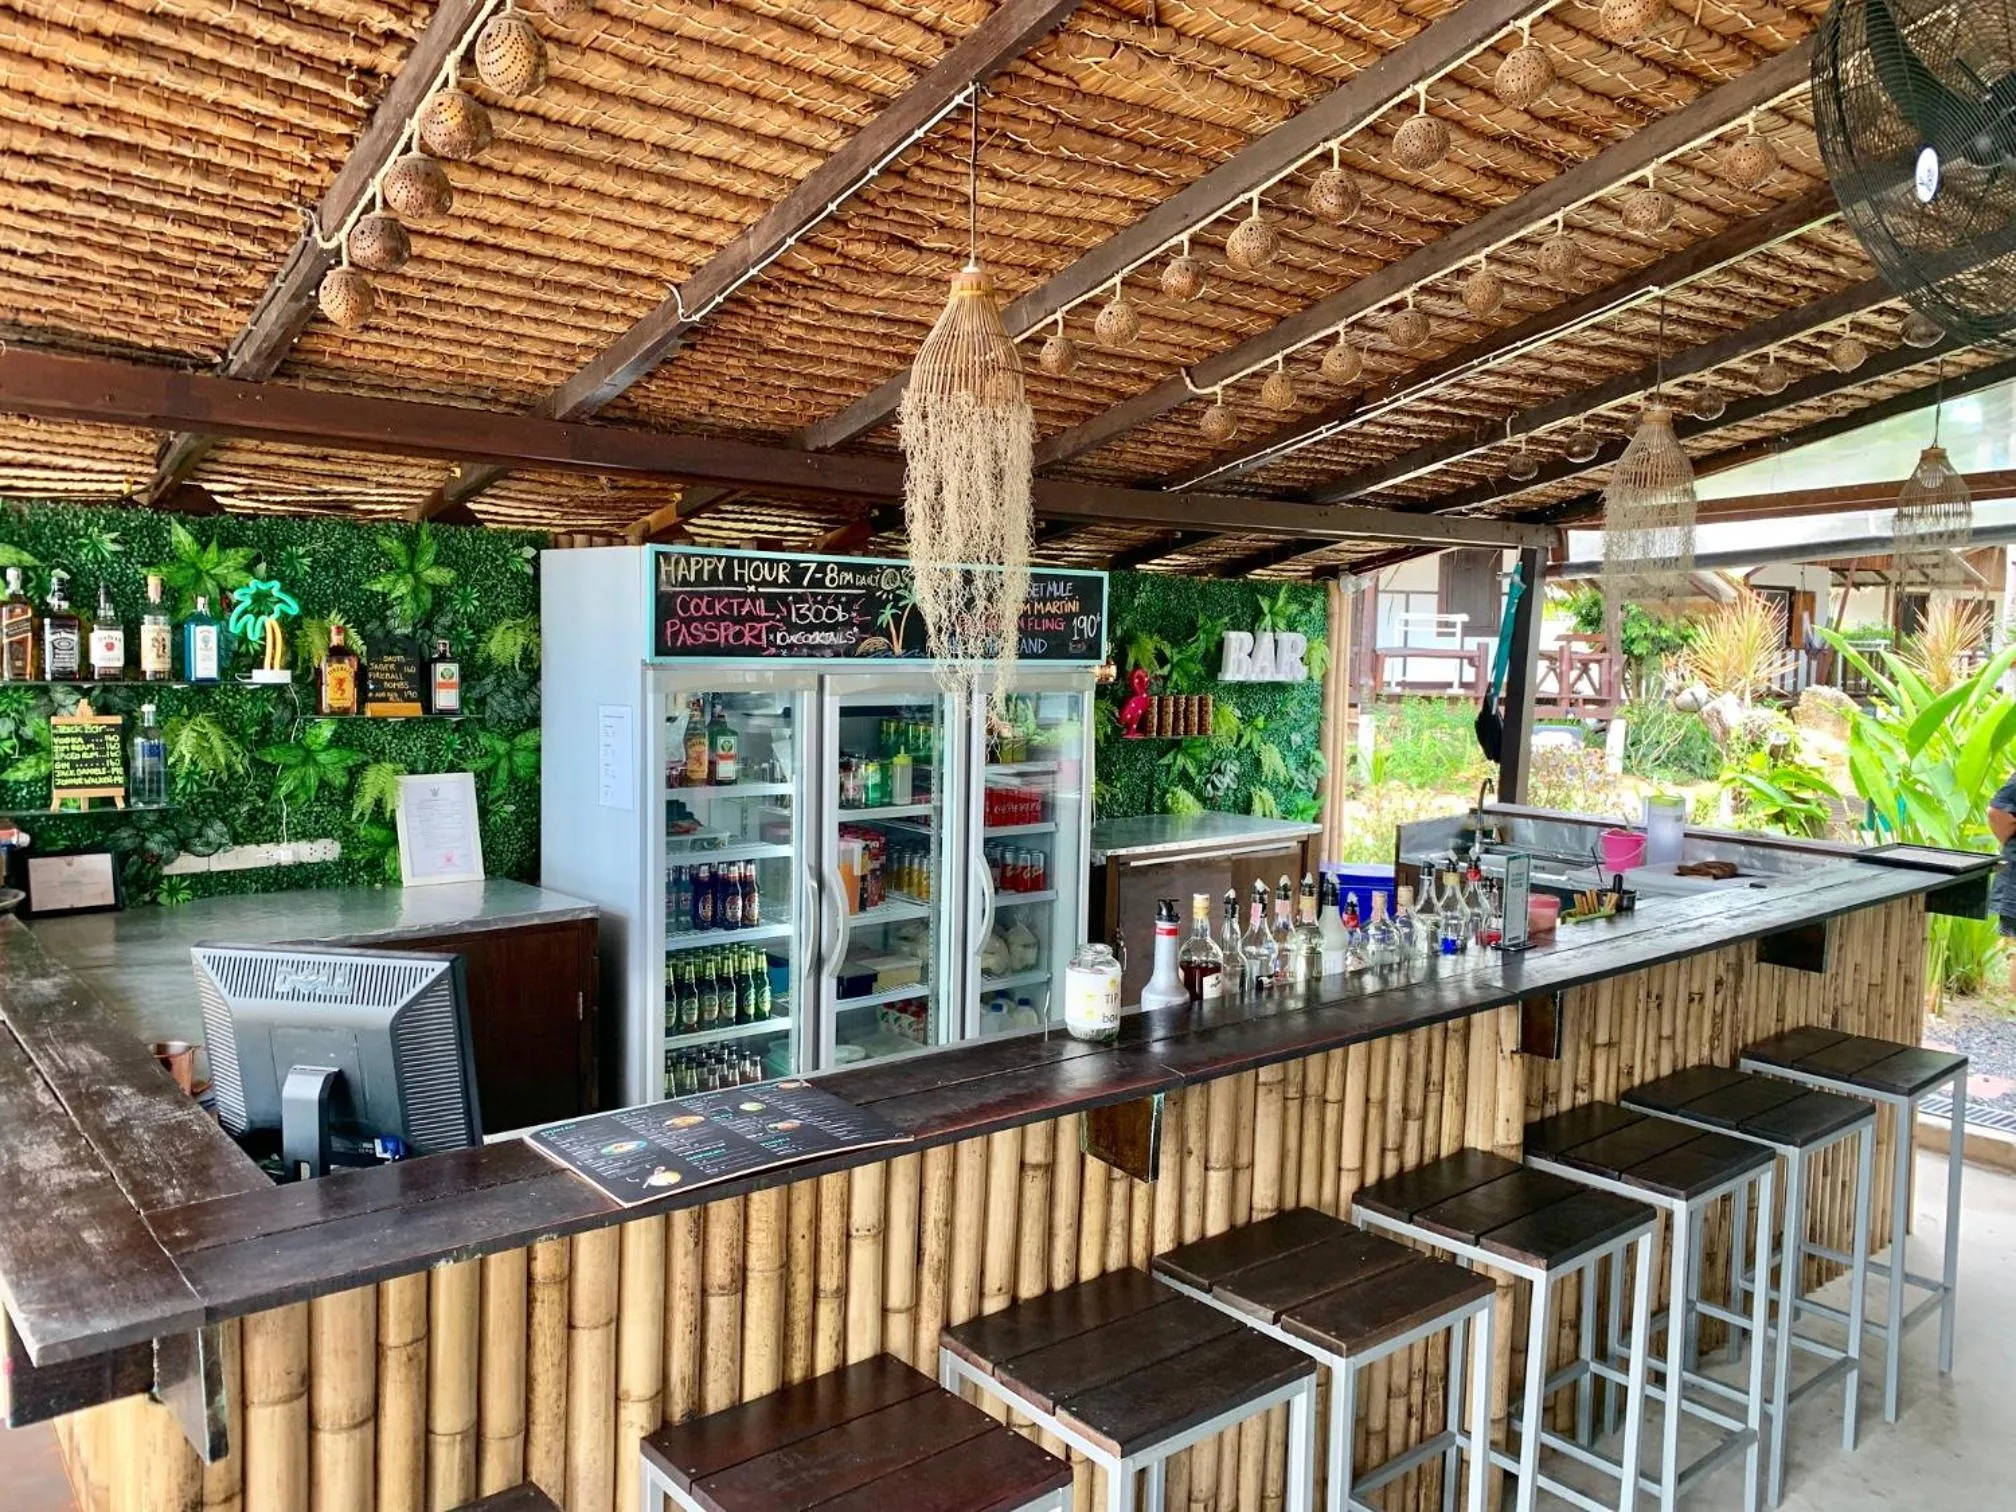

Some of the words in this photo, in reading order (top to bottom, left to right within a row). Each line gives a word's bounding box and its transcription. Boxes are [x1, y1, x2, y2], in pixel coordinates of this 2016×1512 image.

[659, 554, 726, 585] HAPPY
[733, 559, 791, 584] HOUR
[1047, 580, 1073, 598] MULE
[676, 594, 776, 617] COCKTAIL
[1034, 596, 1080, 615] MARTINI
[665, 619, 768, 648] PASSPORT
[1028, 616, 1067, 632] FLING
[1217, 631, 1309, 683] BAR
